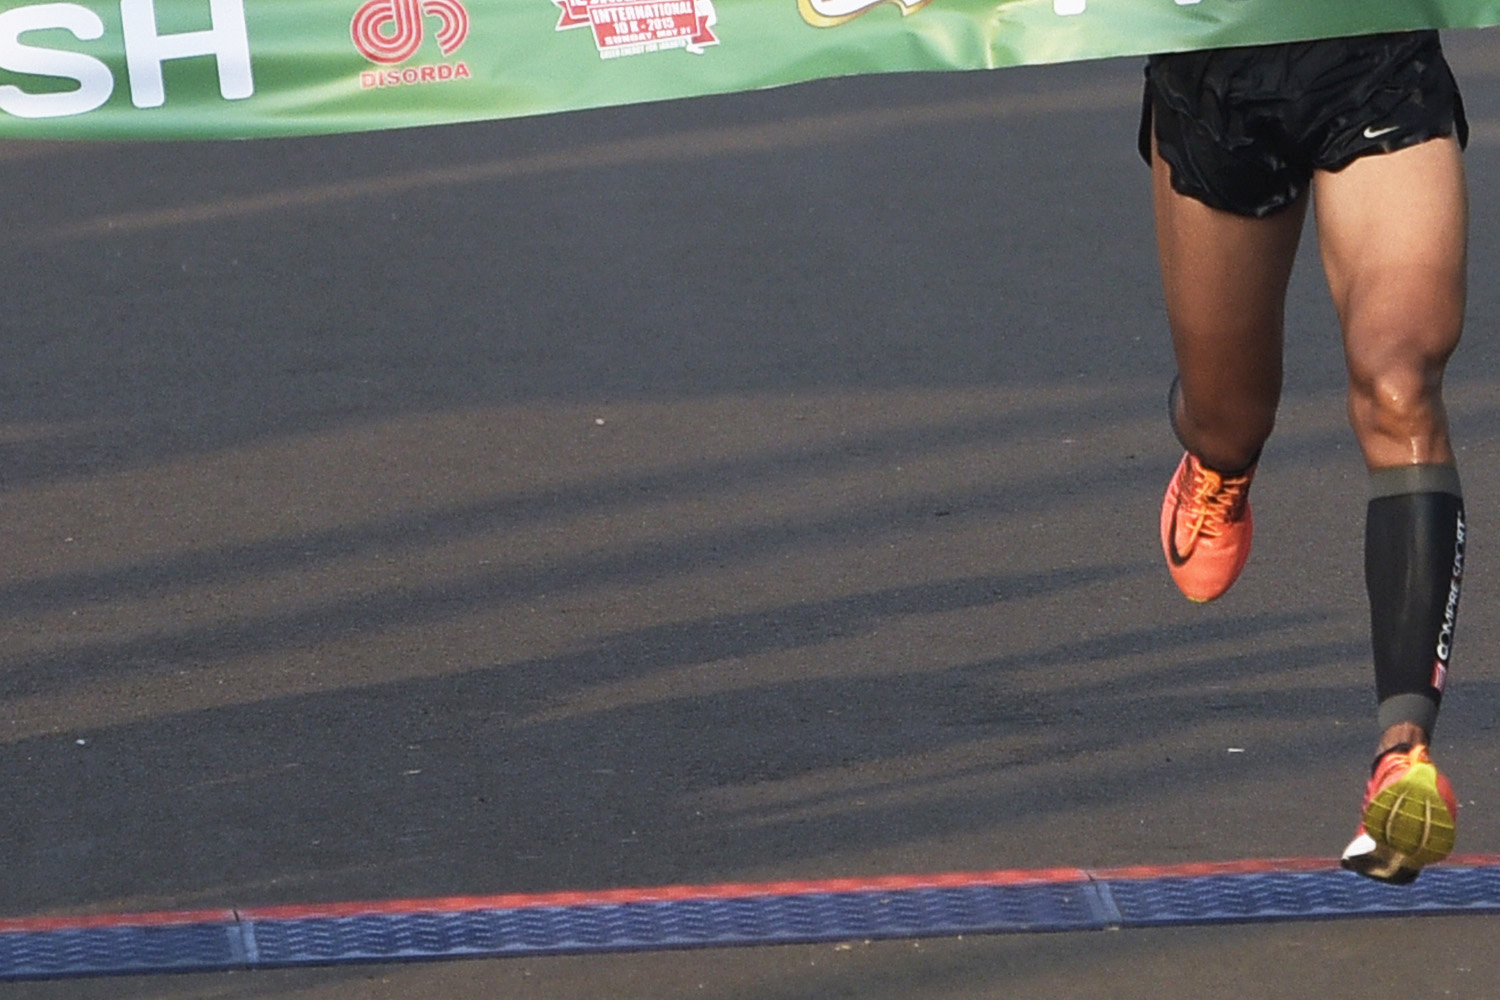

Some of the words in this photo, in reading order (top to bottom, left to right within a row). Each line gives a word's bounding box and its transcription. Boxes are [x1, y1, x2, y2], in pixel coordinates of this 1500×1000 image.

[592, 0, 693, 24] INTERNATIONAL
[612, 21, 629, 35] 10
[629, 20, 640, 33] K
[646, 16, 675, 32] 2015
[361, 62, 471, 88] DISORDA
